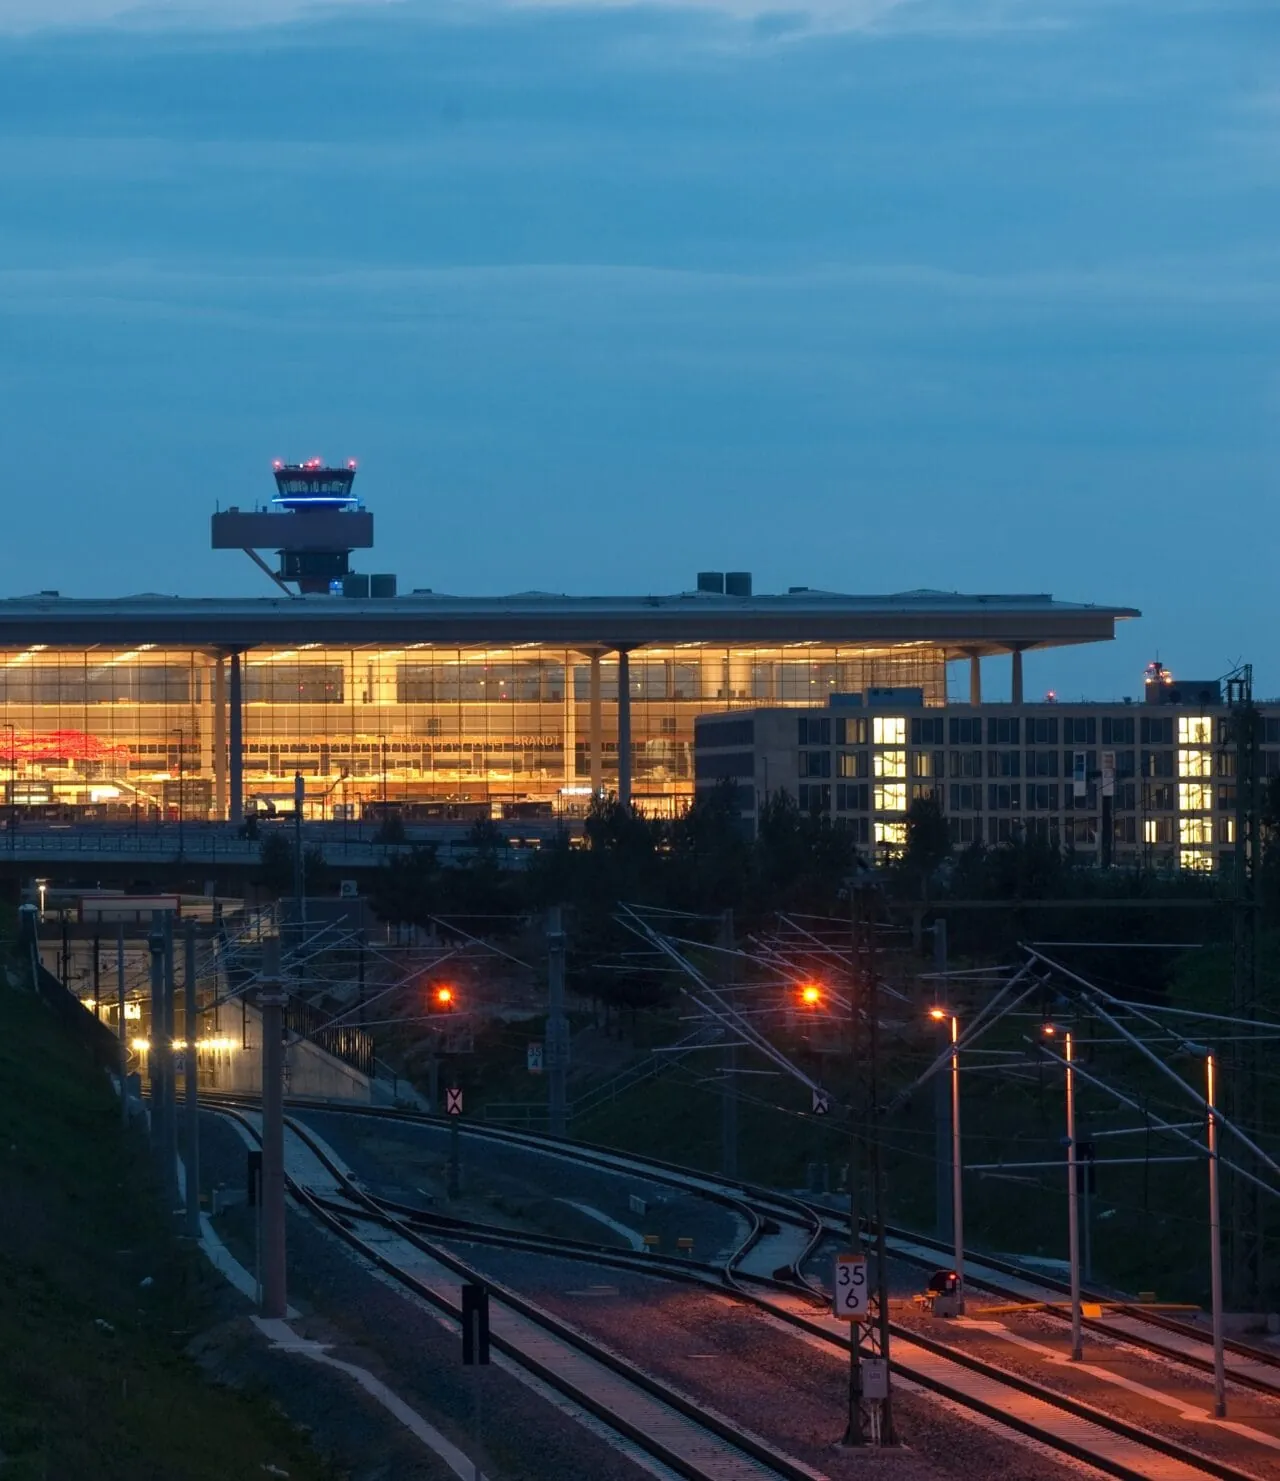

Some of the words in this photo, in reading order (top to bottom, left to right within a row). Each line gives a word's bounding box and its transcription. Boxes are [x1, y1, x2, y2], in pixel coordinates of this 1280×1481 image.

[513, 735, 560, 746] BRANDT
[529, 1047, 542, 1057] 35
[838, 1265, 865, 1286] 35
[845, 1288, 859, 1309] 6
